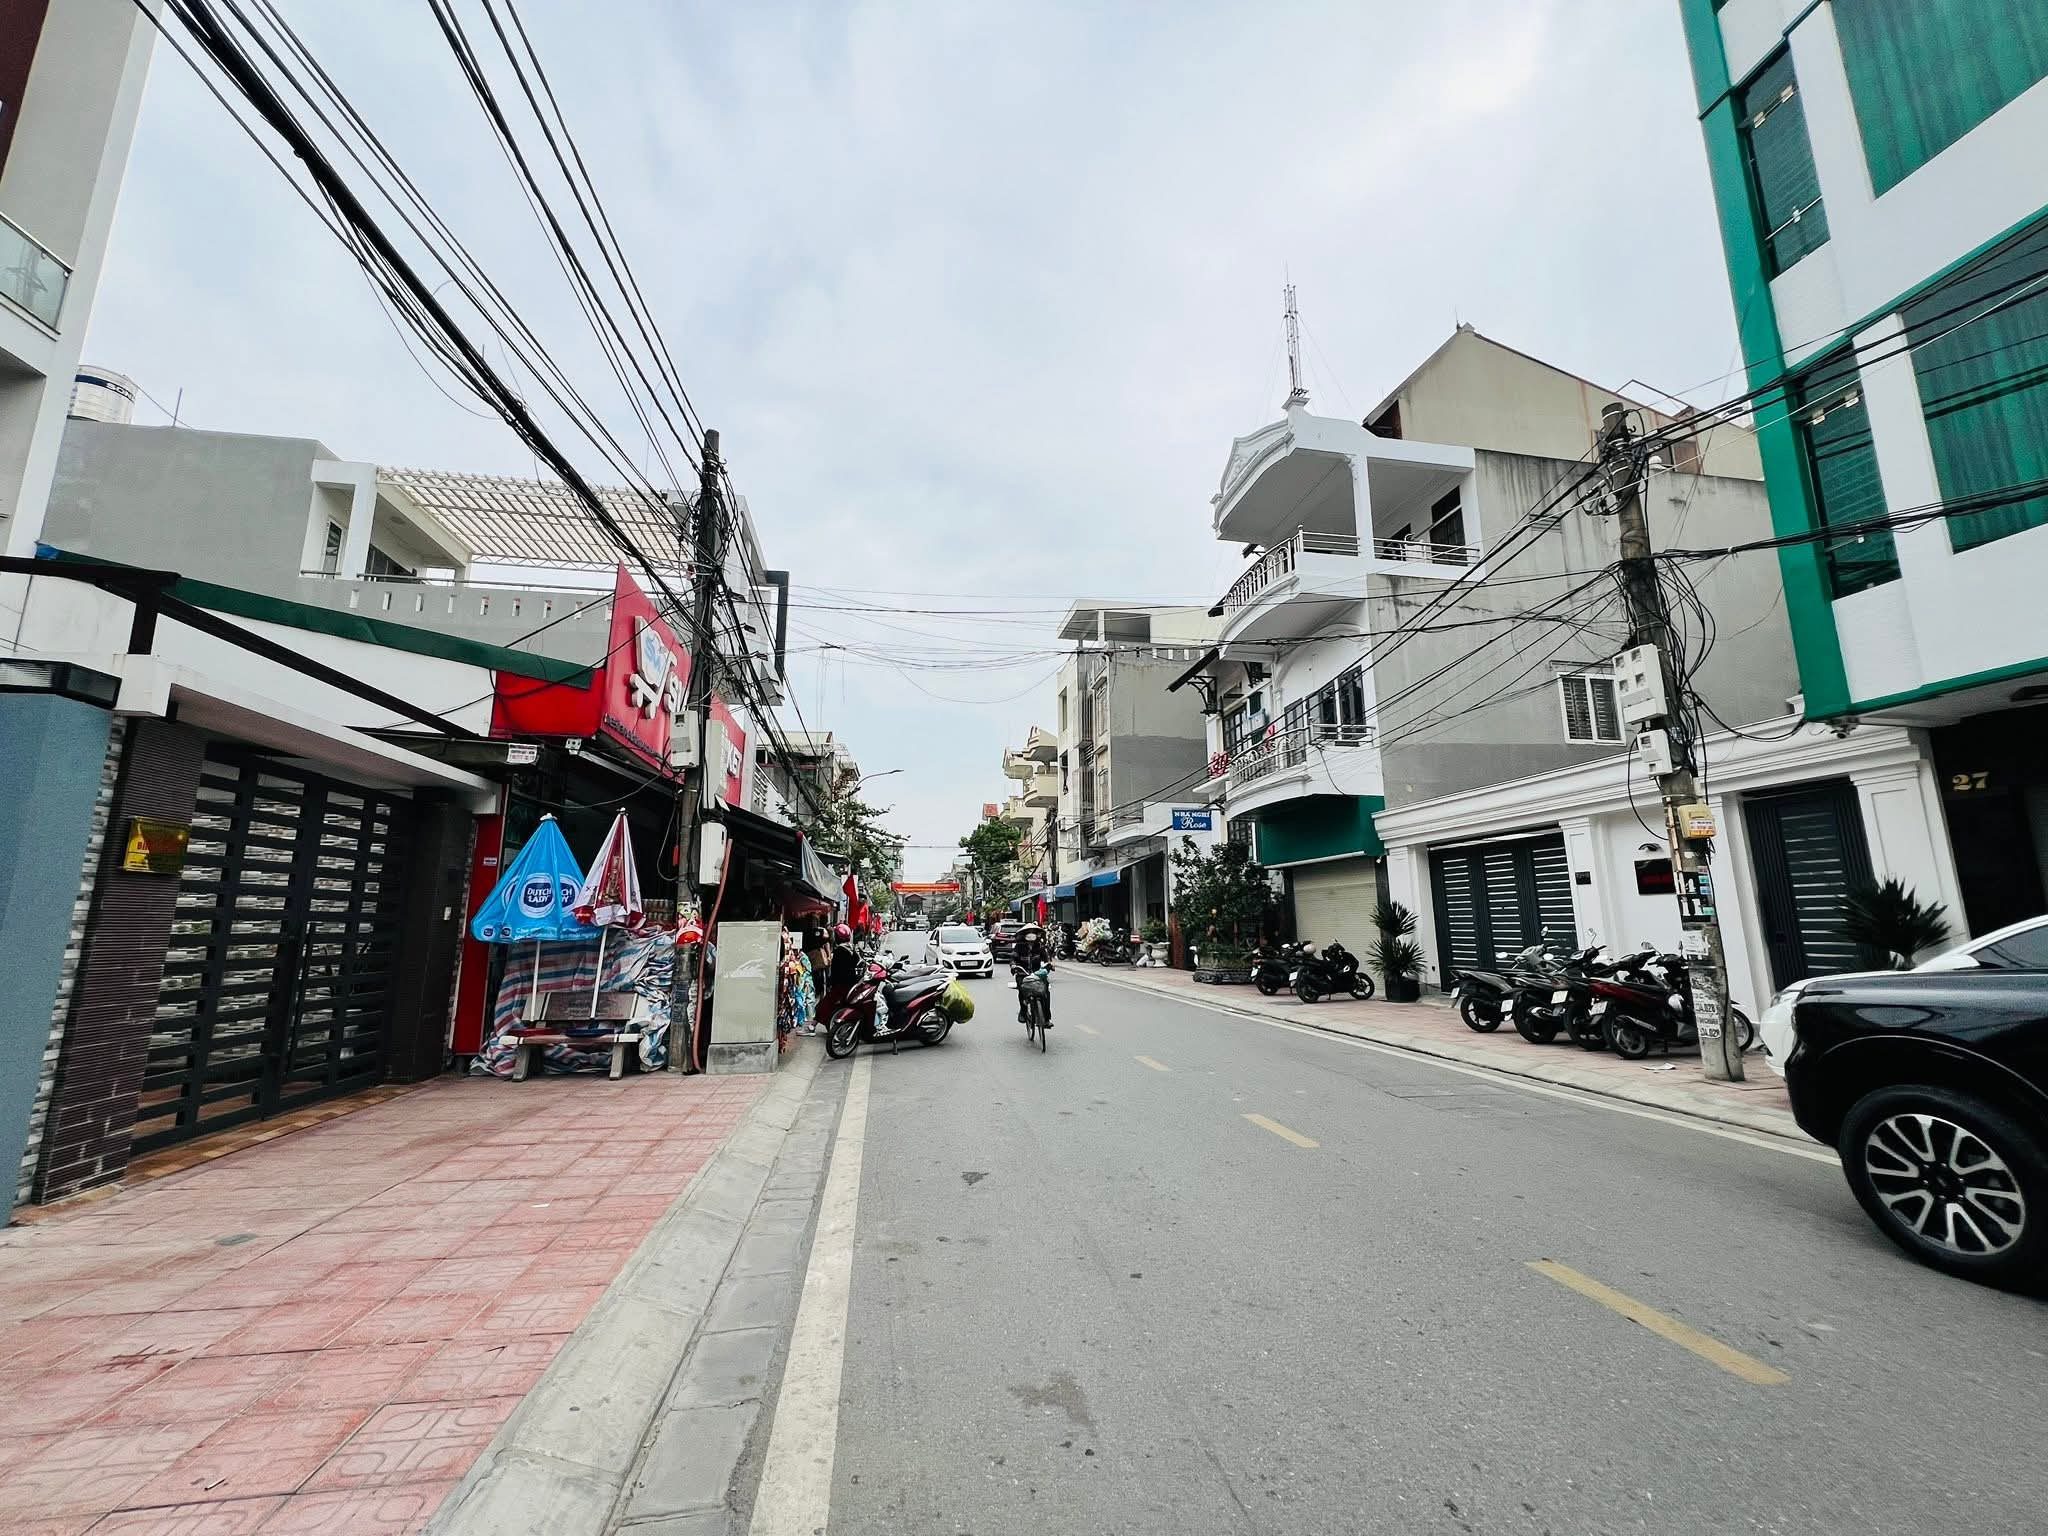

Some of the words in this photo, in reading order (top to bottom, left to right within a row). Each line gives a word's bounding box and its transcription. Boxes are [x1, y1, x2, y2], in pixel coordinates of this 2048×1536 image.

[1952, 772, 1989, 790] 27
[1181, 816, 1207, 829] Rose
[527, 887, 552, 896] DUTCH
[528, 895, 549, 903] LADY
